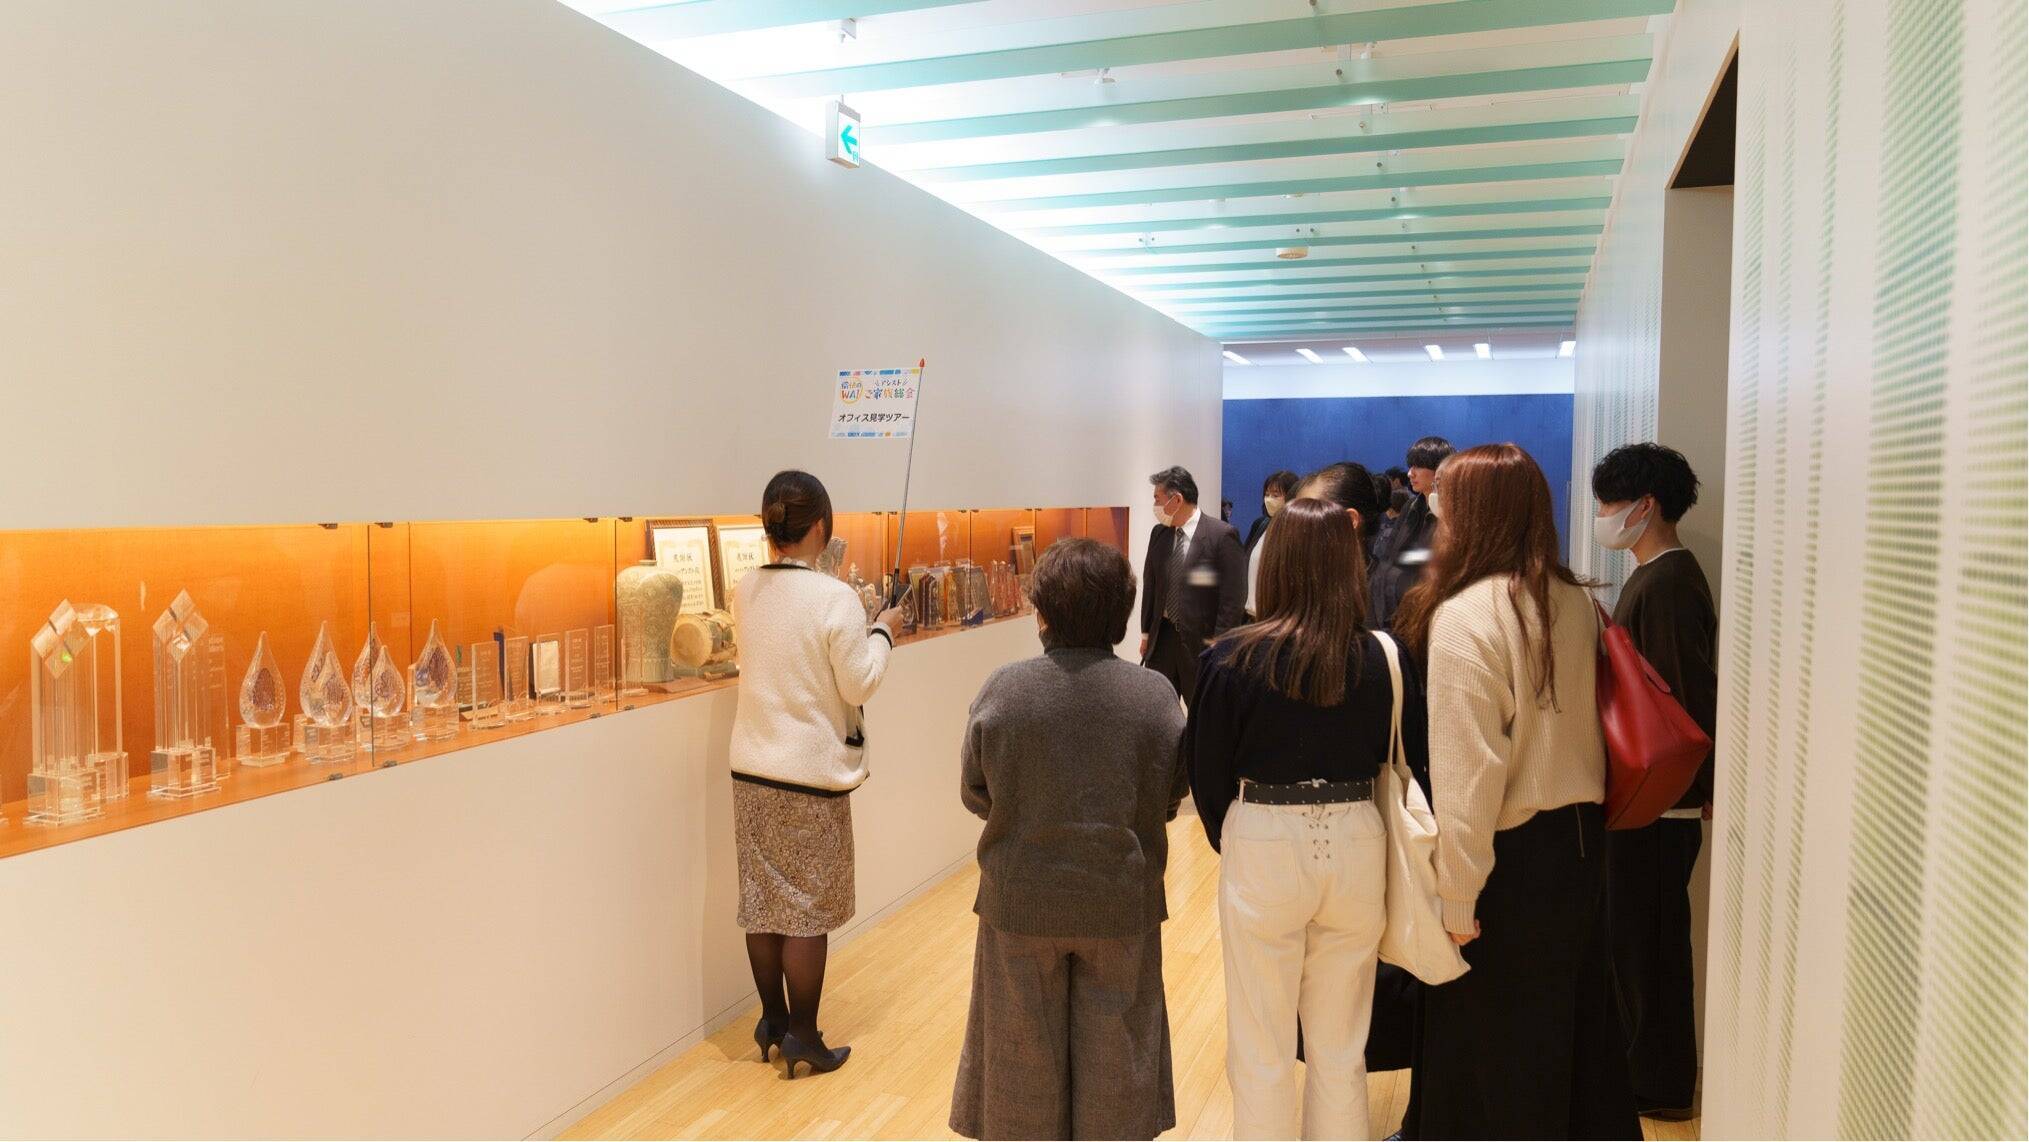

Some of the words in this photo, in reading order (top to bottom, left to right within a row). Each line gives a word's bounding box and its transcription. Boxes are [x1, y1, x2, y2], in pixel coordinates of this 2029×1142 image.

[838, 413, 910, 422] オフィス見学ツアー
